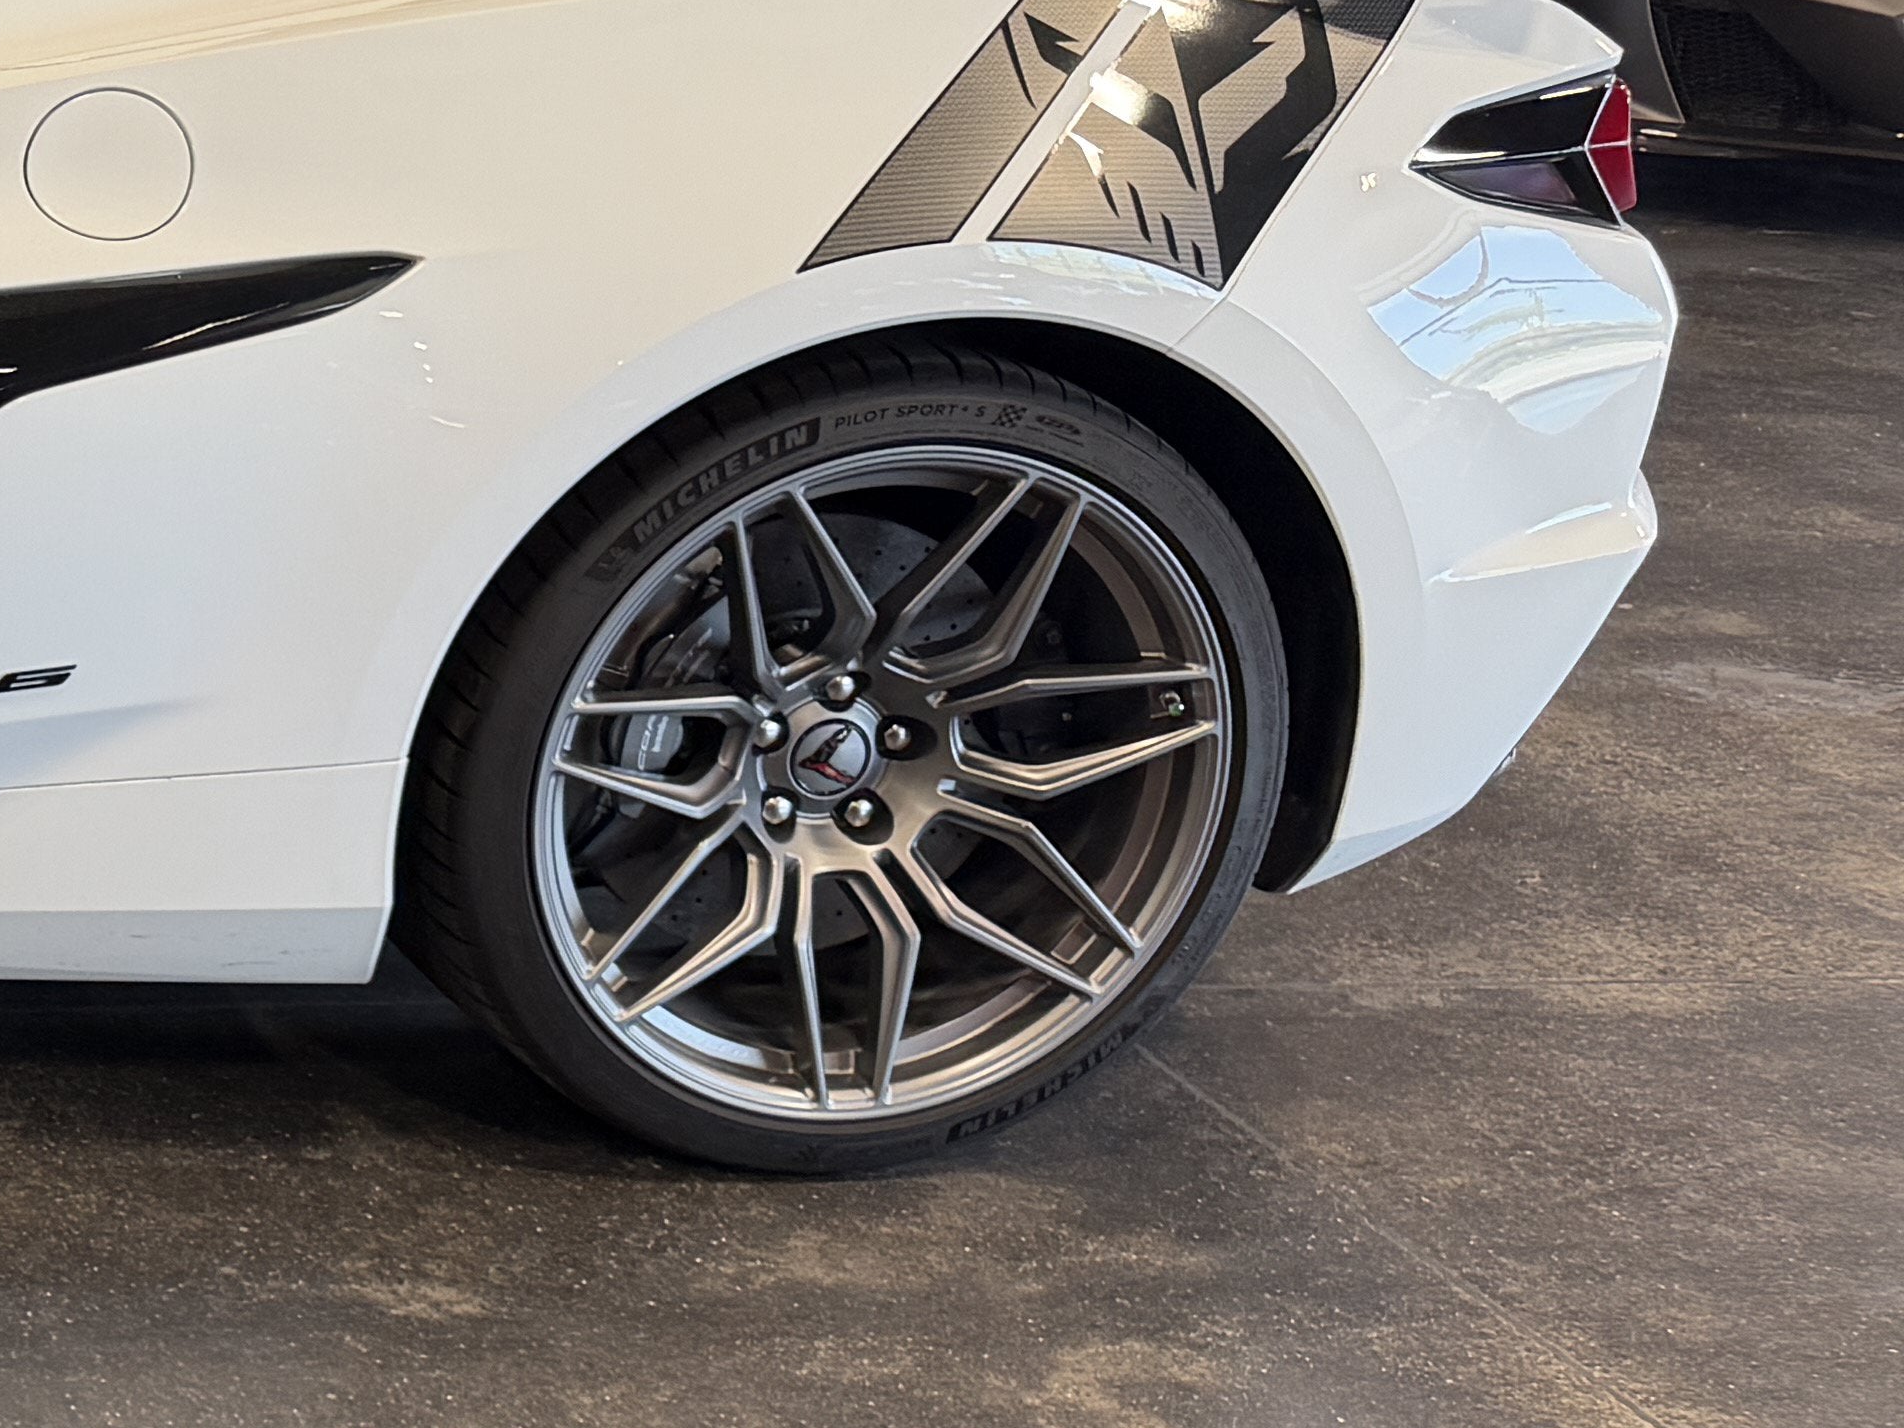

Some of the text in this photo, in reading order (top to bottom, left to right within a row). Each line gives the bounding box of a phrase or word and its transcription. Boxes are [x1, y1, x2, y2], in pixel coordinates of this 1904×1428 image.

[834, 408, 889, 431] PILOT
[895, 403, 960, 419] SPORT
[974, 405, 987, 418] S
[632, 423, 809, 545] MICHELIN
[959, 1029, 1125, 1137] MICHELIN
